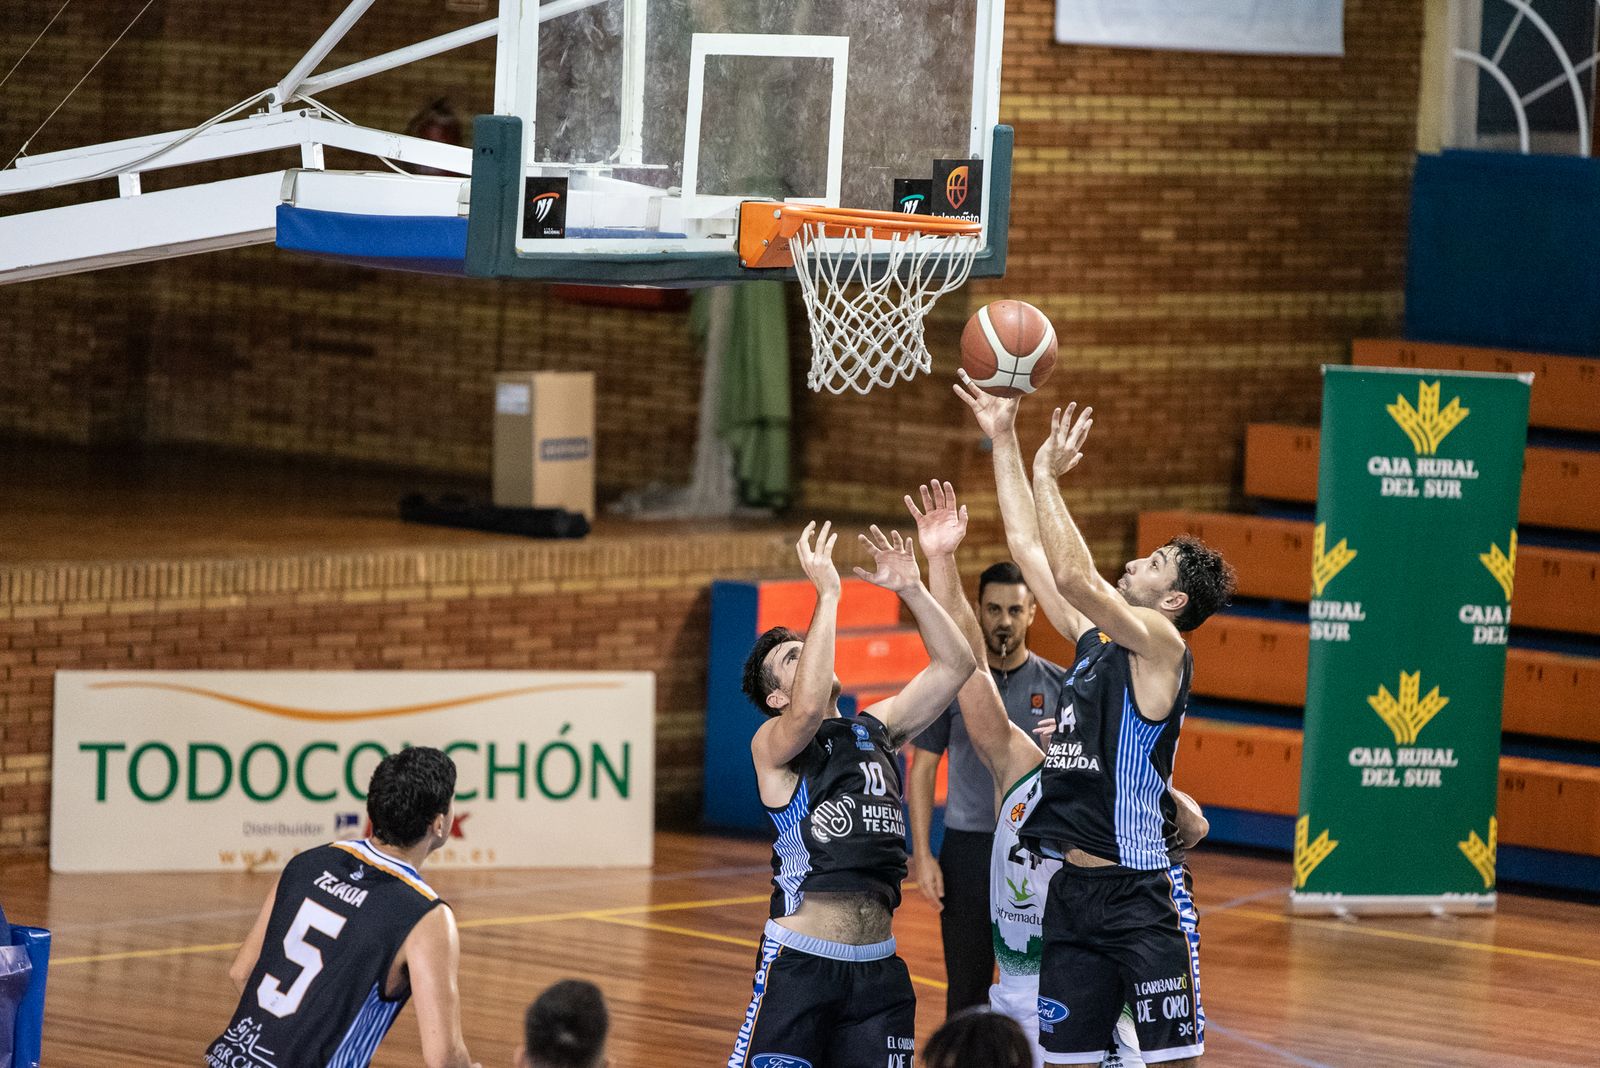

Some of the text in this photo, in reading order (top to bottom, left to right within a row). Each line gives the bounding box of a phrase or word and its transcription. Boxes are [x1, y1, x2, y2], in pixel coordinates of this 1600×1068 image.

[1367, 456, 1479, 479] CAJA RURAL
[1381, 478, 1462, 499] DEL SUR
[1459, 605, 1503, 624] CAJA
[1310, 622, 1350, 641] SUR
[79, 723, 632, 802] TODOCOCHÓN
[1348, 747, 1458, 768] CAJA RURAL
[859, 762, 886, 796] 10
[1361, 768, 1442, 788] DEL SUR
[862, 804, 904, 824] HUELVA
[242, 821, 323, 836] Distribuidor
[863, 818, 881, 832] TE
[313, 870, 369, 908] TEJADA
[257, 897, 348, 1018] 5
[1136, 993, 1190, 1024] DE ORO
[887, 1035, 898, 1049] EL
